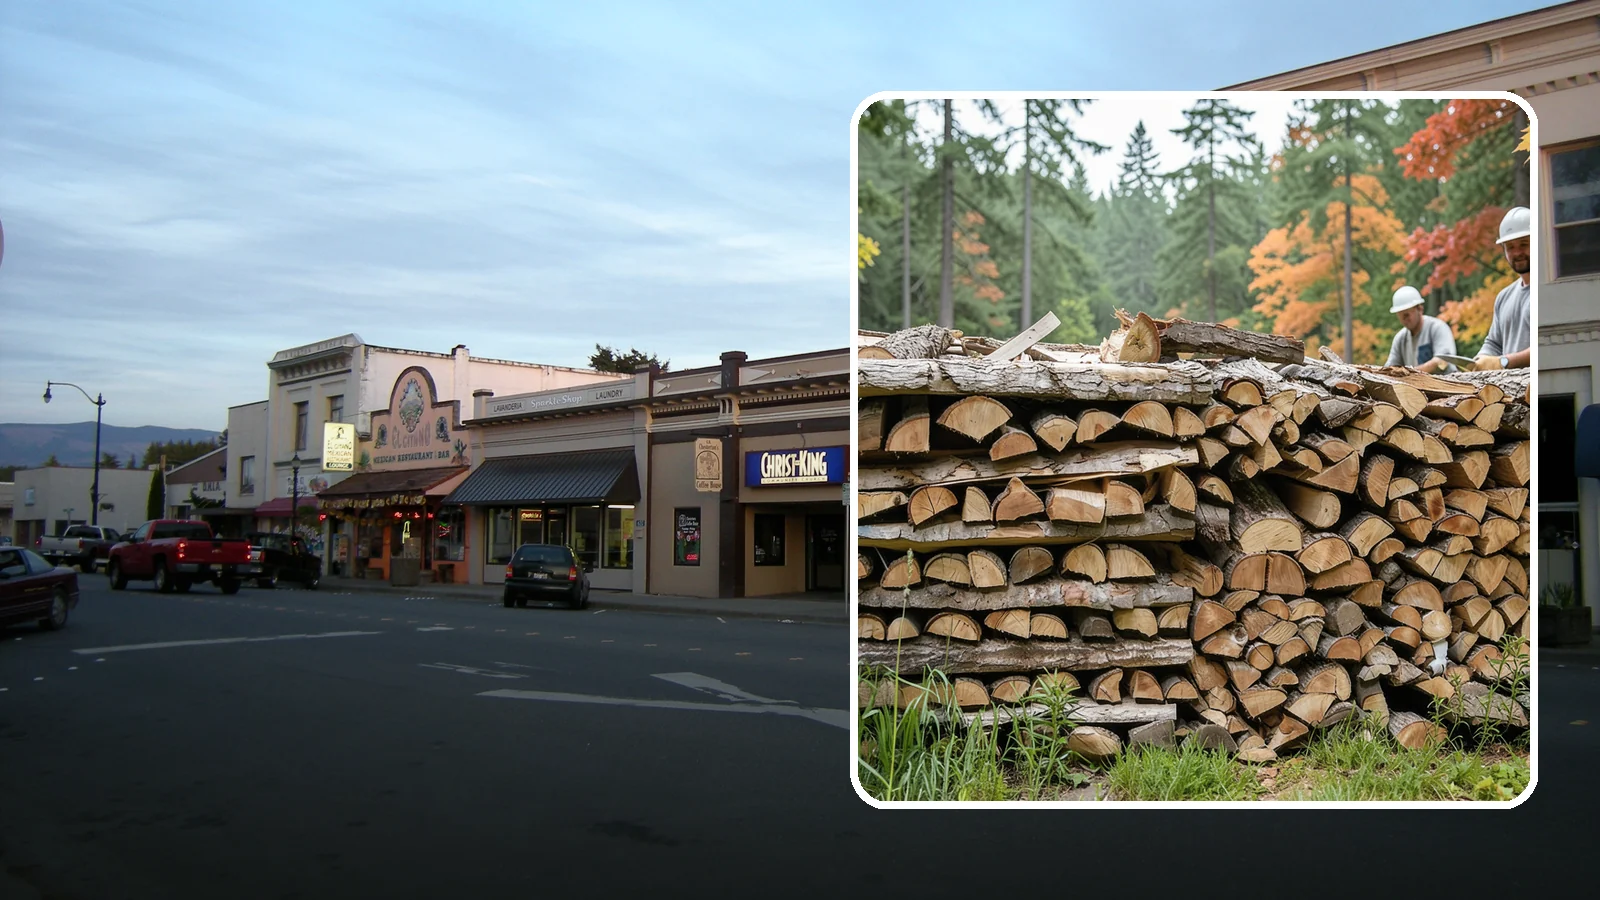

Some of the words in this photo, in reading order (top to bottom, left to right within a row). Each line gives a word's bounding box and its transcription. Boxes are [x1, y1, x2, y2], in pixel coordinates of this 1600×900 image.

[530, 398, 560, 409] Sparkle
[561, 394, 583, 405] Shop
[595, 389, 623, 400] LAUNDRY
[493, 402, 523, 412] LAVANDERIA
[373, 455, 396, 464] MEXICAN
[397, 451, 434, 462] RESTAURANT
[437, 450, 450, 459] BAR
[761, 452, 797, 478] CHRIST
[799, 450, 827, 476] KING
